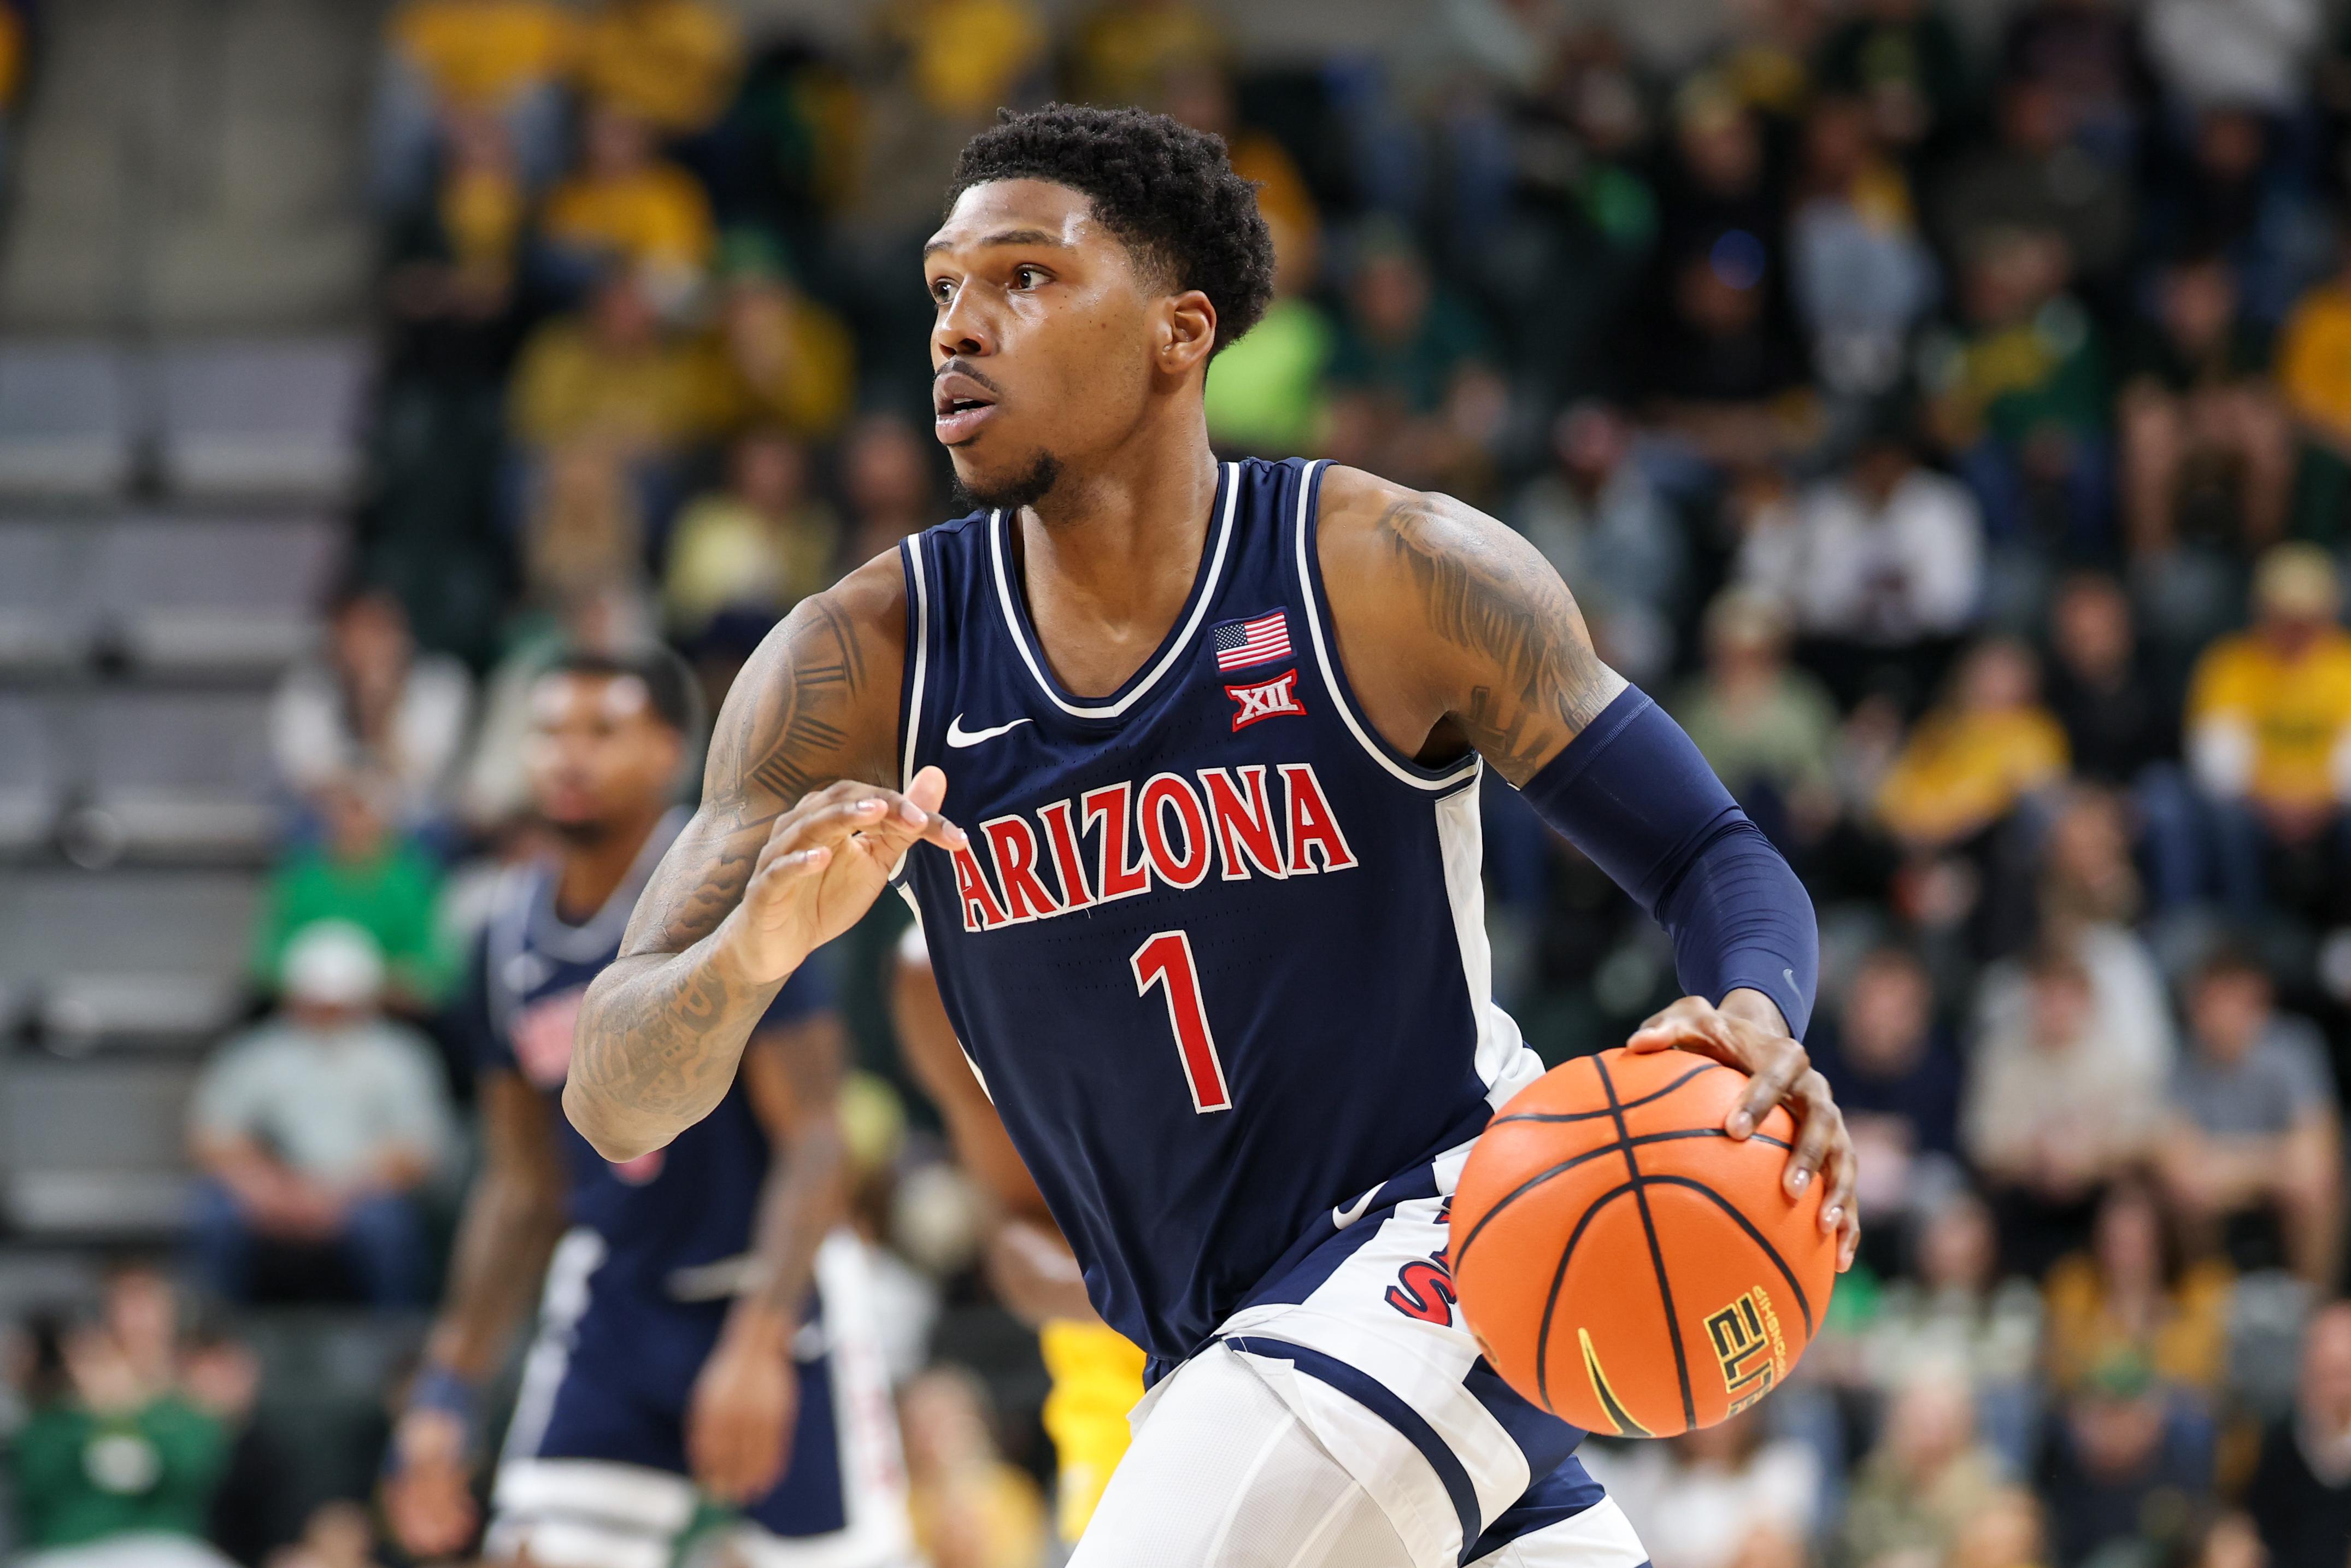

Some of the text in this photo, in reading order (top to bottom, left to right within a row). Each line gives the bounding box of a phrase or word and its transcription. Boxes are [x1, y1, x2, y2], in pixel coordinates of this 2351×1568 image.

[1230, 675, 1299, 725] XII
[949, 763, 1359, 932] ARIZONA
[1129, 929, 1233, 1115] 1
